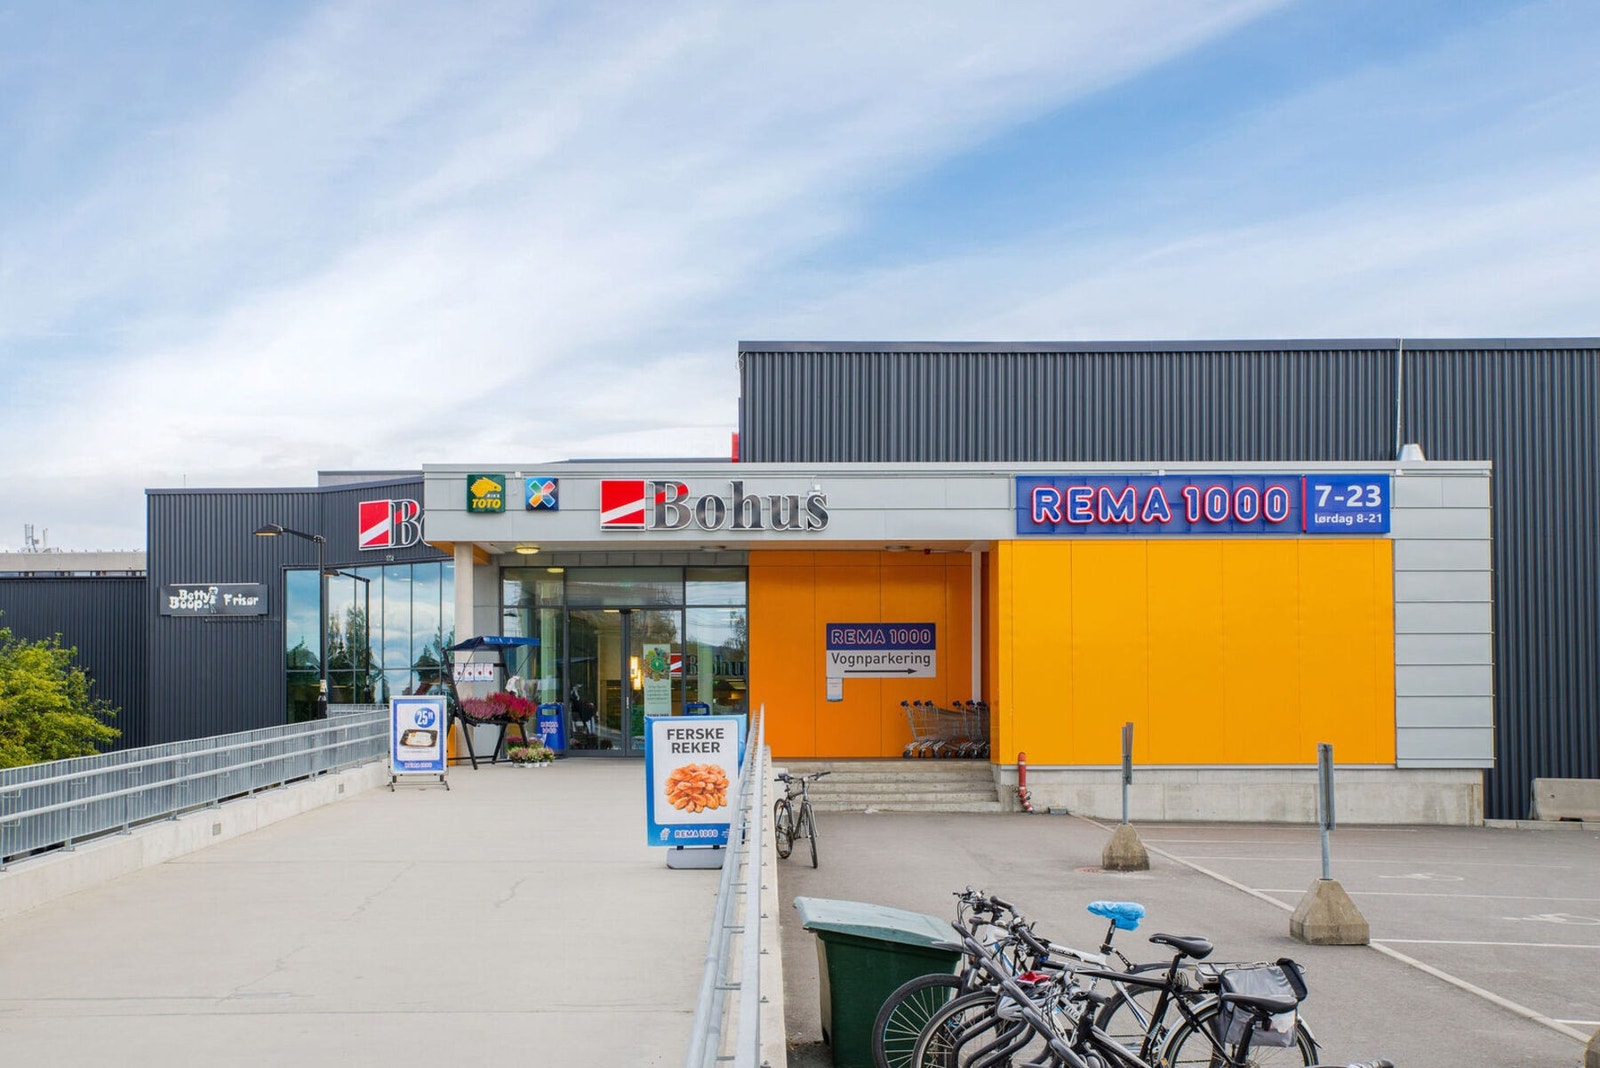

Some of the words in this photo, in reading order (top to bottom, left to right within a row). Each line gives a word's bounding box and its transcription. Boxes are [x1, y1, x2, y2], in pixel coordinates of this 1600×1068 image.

[472, 498, 501, 509] TOTO
[1314, 485, 1382, 507] 7-23
[648, 480, 829, 531] Bohus
[1031, 485, 1171, 524] REMA
[1181, 485, 1290, 524] 1000
[389, 499, 432, 548] B
[1315, 513, 1353, 526] lørdag
[1356, 514, 1382, 524] 8-21
[169, 596, 203, 611] Boop
[831, 629, 886, 645] REMA
[889, 629, 931, 645] 1000
[831, 652, 931, 667] Vognparkering
[416, 710, 428, 725] 25
[667, 728, 724, 740] FERSKE
[671, 742, 720, 754] REKER
[674, 829, 700, 838] REMA
[700, 829, 719, 838] 1000
